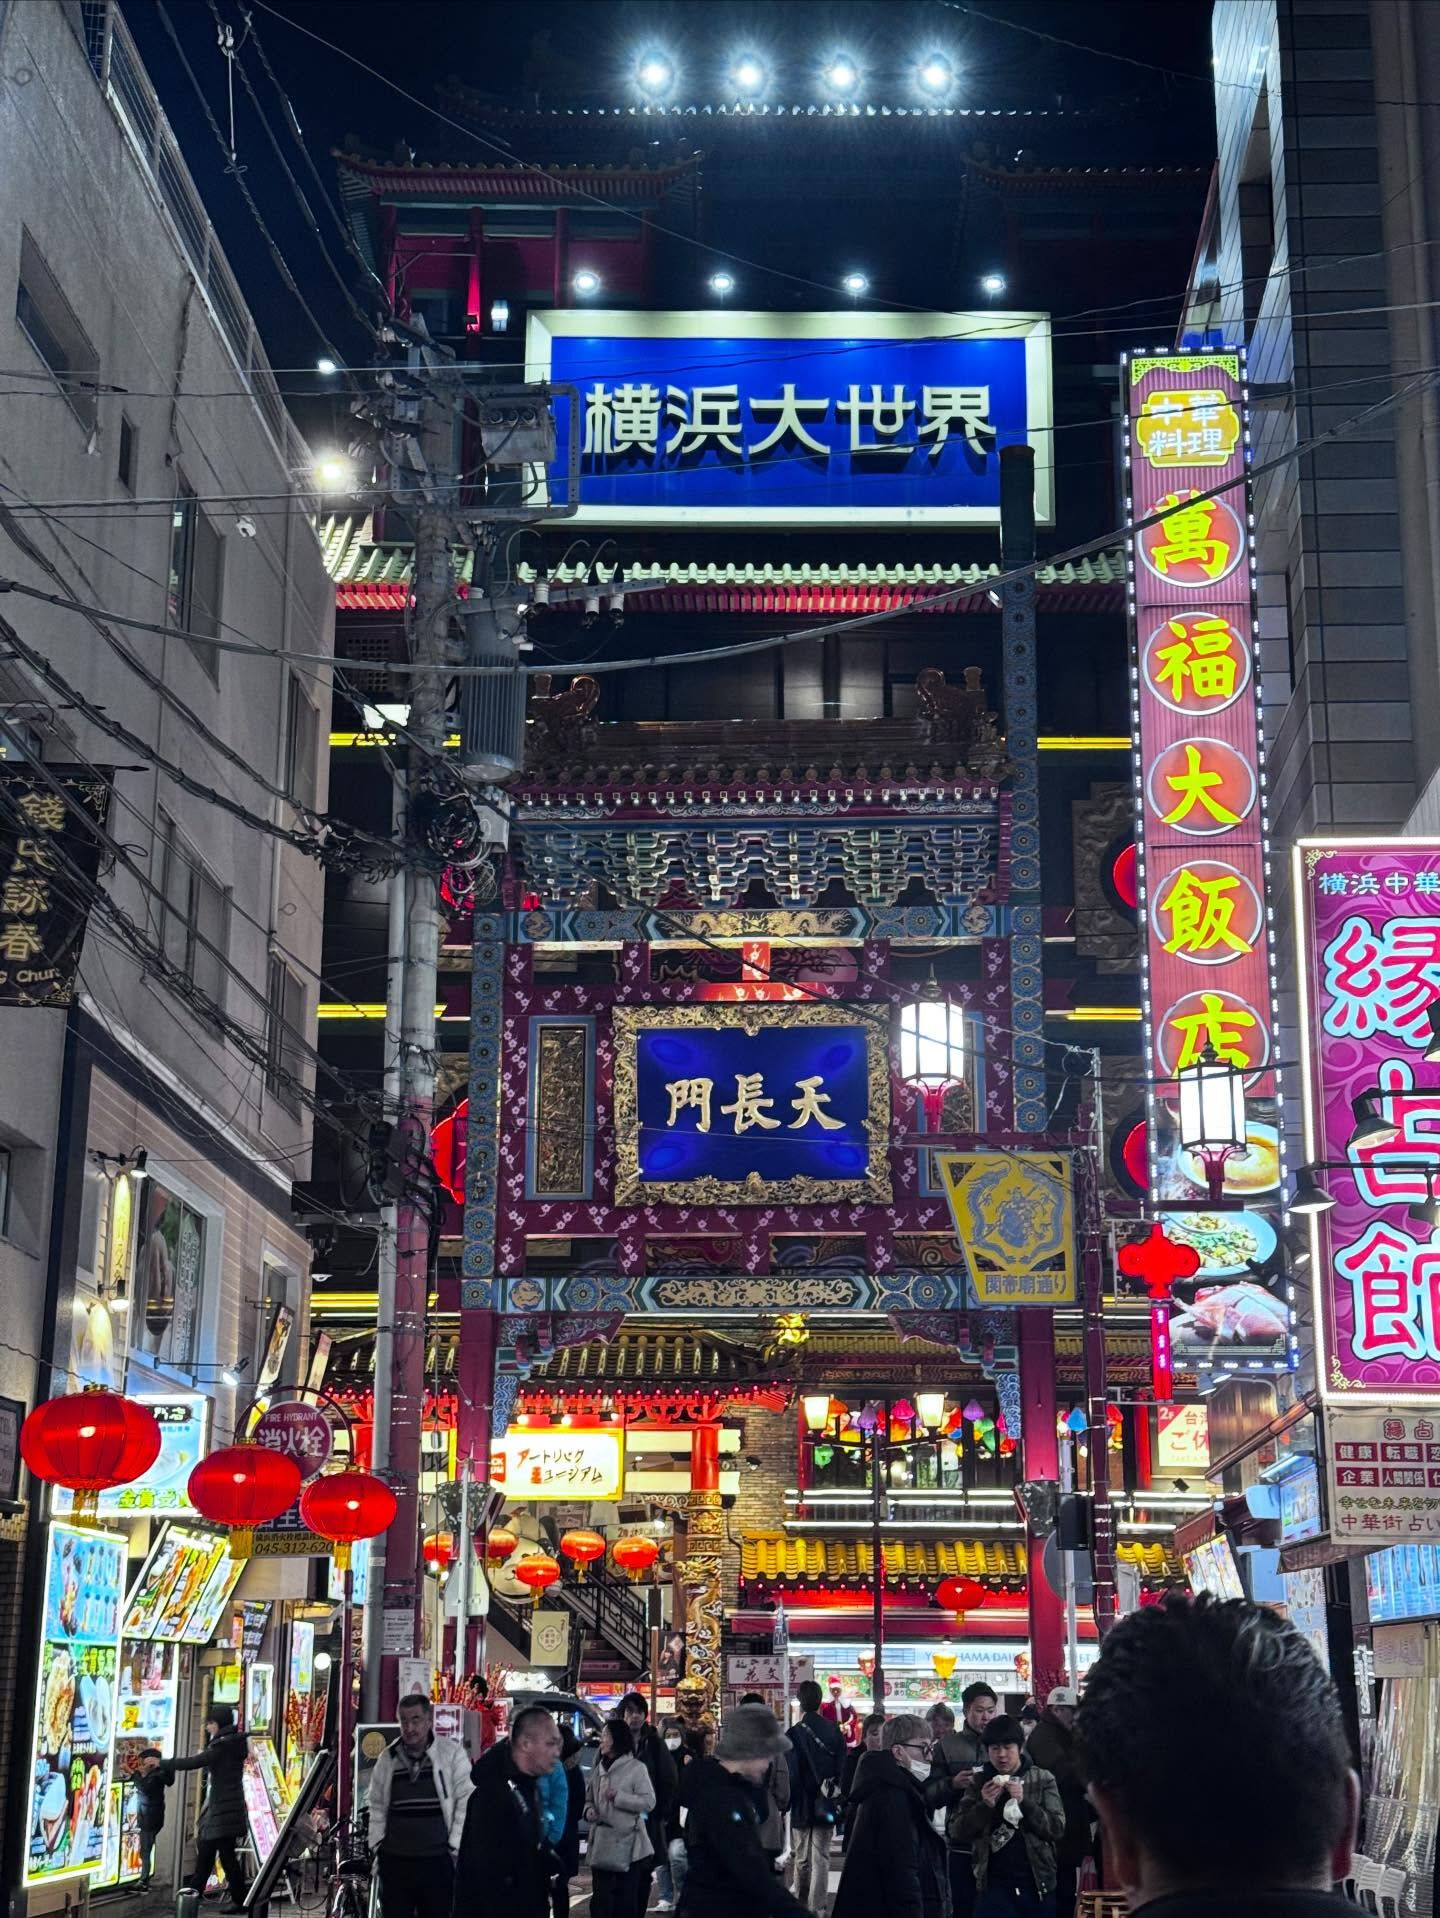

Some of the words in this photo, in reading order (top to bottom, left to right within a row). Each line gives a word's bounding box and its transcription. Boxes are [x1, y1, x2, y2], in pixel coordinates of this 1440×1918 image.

[1150, 394, 1226, 426] 中華
[583, 384, 996, 455] 横浜大世界
[1149, 428, 1222, 458] 料理
[265, 1413, 281, 1423] FIRE
[283, 1412, 319, 1422] HYDRANT
[259, 1426, 325, 1457] 消火栓
[1340, 1445, 1373, 1459] 健康
[1386, 1446, 1419, 1459] 転職
[1342, 1469, 1374, 1485] 企業
[1383, 1471, 1424, 1485] 人間関係
